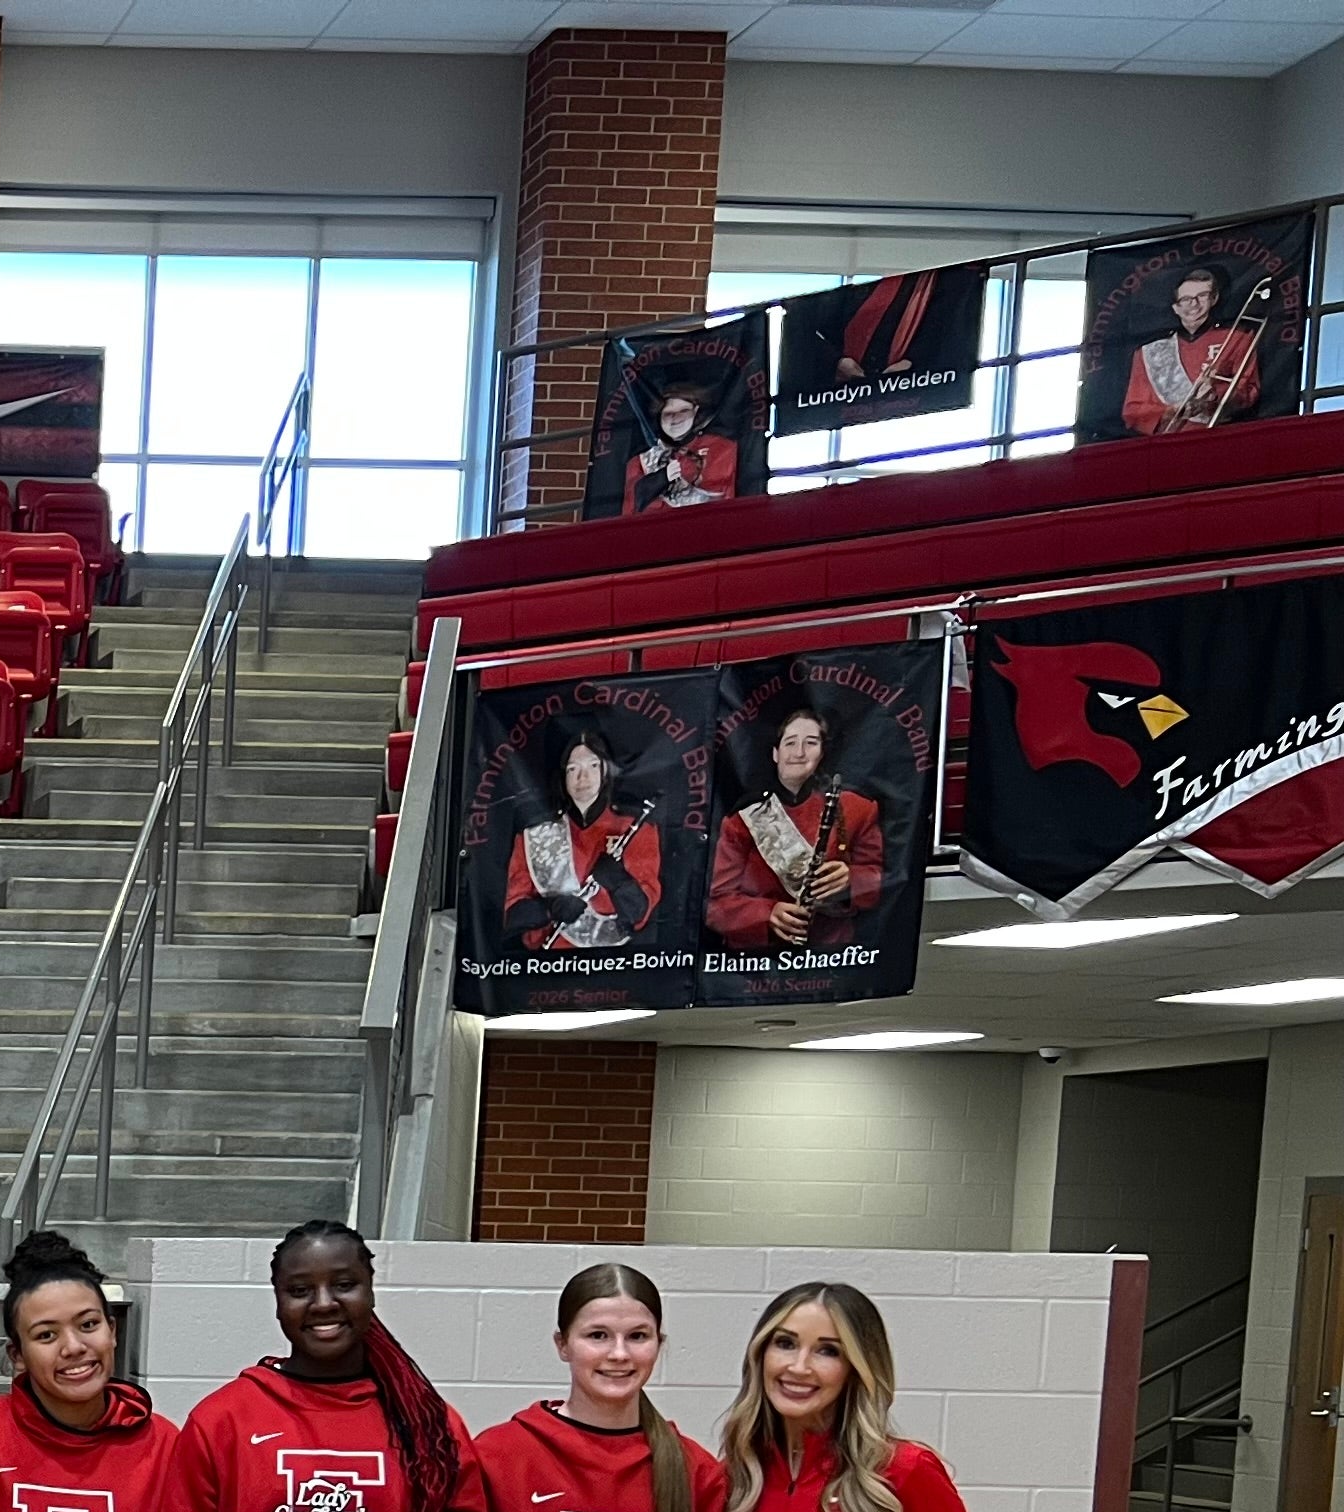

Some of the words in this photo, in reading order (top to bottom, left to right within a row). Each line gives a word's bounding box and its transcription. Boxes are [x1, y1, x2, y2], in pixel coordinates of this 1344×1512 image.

[1085, 249, 1181, 374] Farmington
[1192, 237, 1288, 276] Cardinal
[1280, 276, 1302, 343] Band
[668, 338, 755, 370] Cardinal
[747, 371, 768, 431] Band
[797, 384, 872, 409] Lundyn
[878, 369, 957, 393] Welden
[789, 659, 904, 708] Cardinal
[896, 704, 934, 773] Band
[464, 693, 564, 846] Farmington
[574, 682, 698, 743] Cardinal
[682, 745, 710, 830] Band
[461, 957, 521, 979] Saydie
[526, 952, 693, 976] Rodriquez-Boivin
[702, 952, 770, 973] Elaina
[777, 945, 878, 971] Schaeffer
[528, 989, 569, 1006] 2026
[574, 988, 628, 1004] Senior
[743, 977, 781, 993] 2026
[784, 976, 834, 991] Senior
[295, 1478, 352, 1512] Lady
